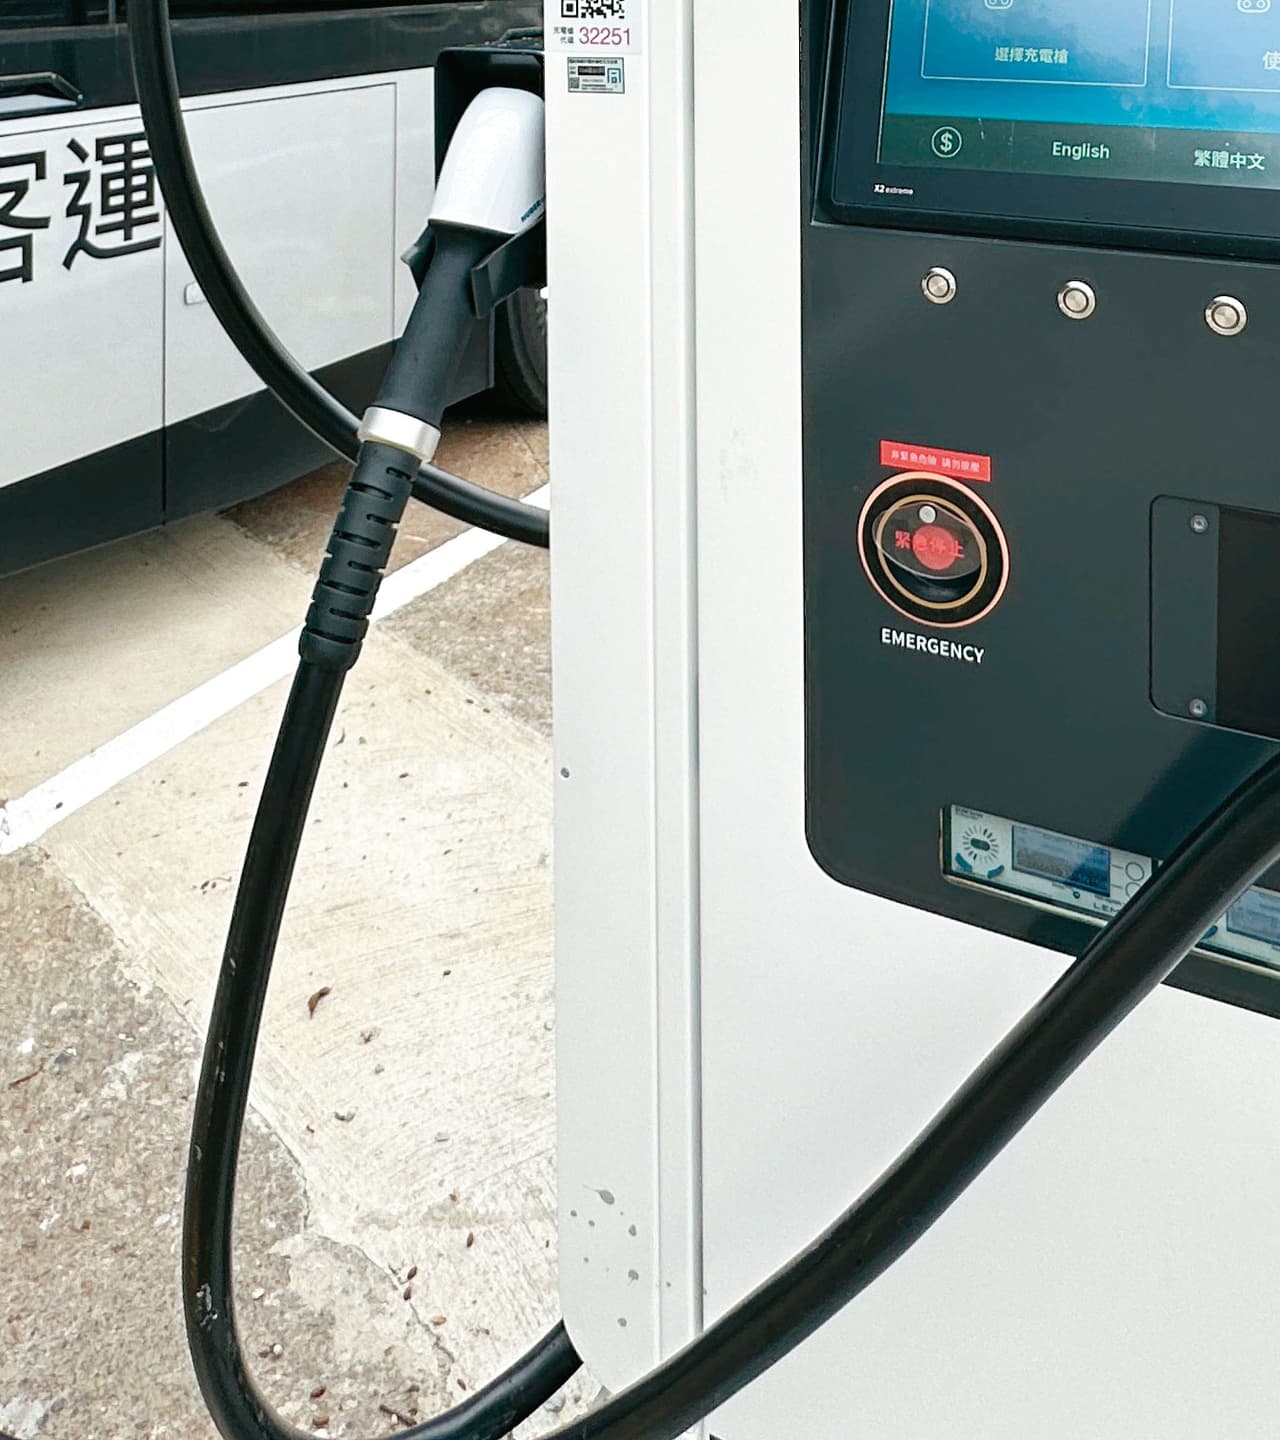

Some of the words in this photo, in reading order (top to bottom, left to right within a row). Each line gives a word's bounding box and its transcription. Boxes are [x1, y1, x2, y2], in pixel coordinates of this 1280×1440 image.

[579, 26, 630, 45] 32251
[995, 47, 1069, 64] 選擇充電槍
[1052, 141, 1110, 160] English
[1193, 149, 1265, 170] 繁體中文
[895, 530, 965, 559] 緊急停止
[881, 627, 985, 664] EMERGENCY
